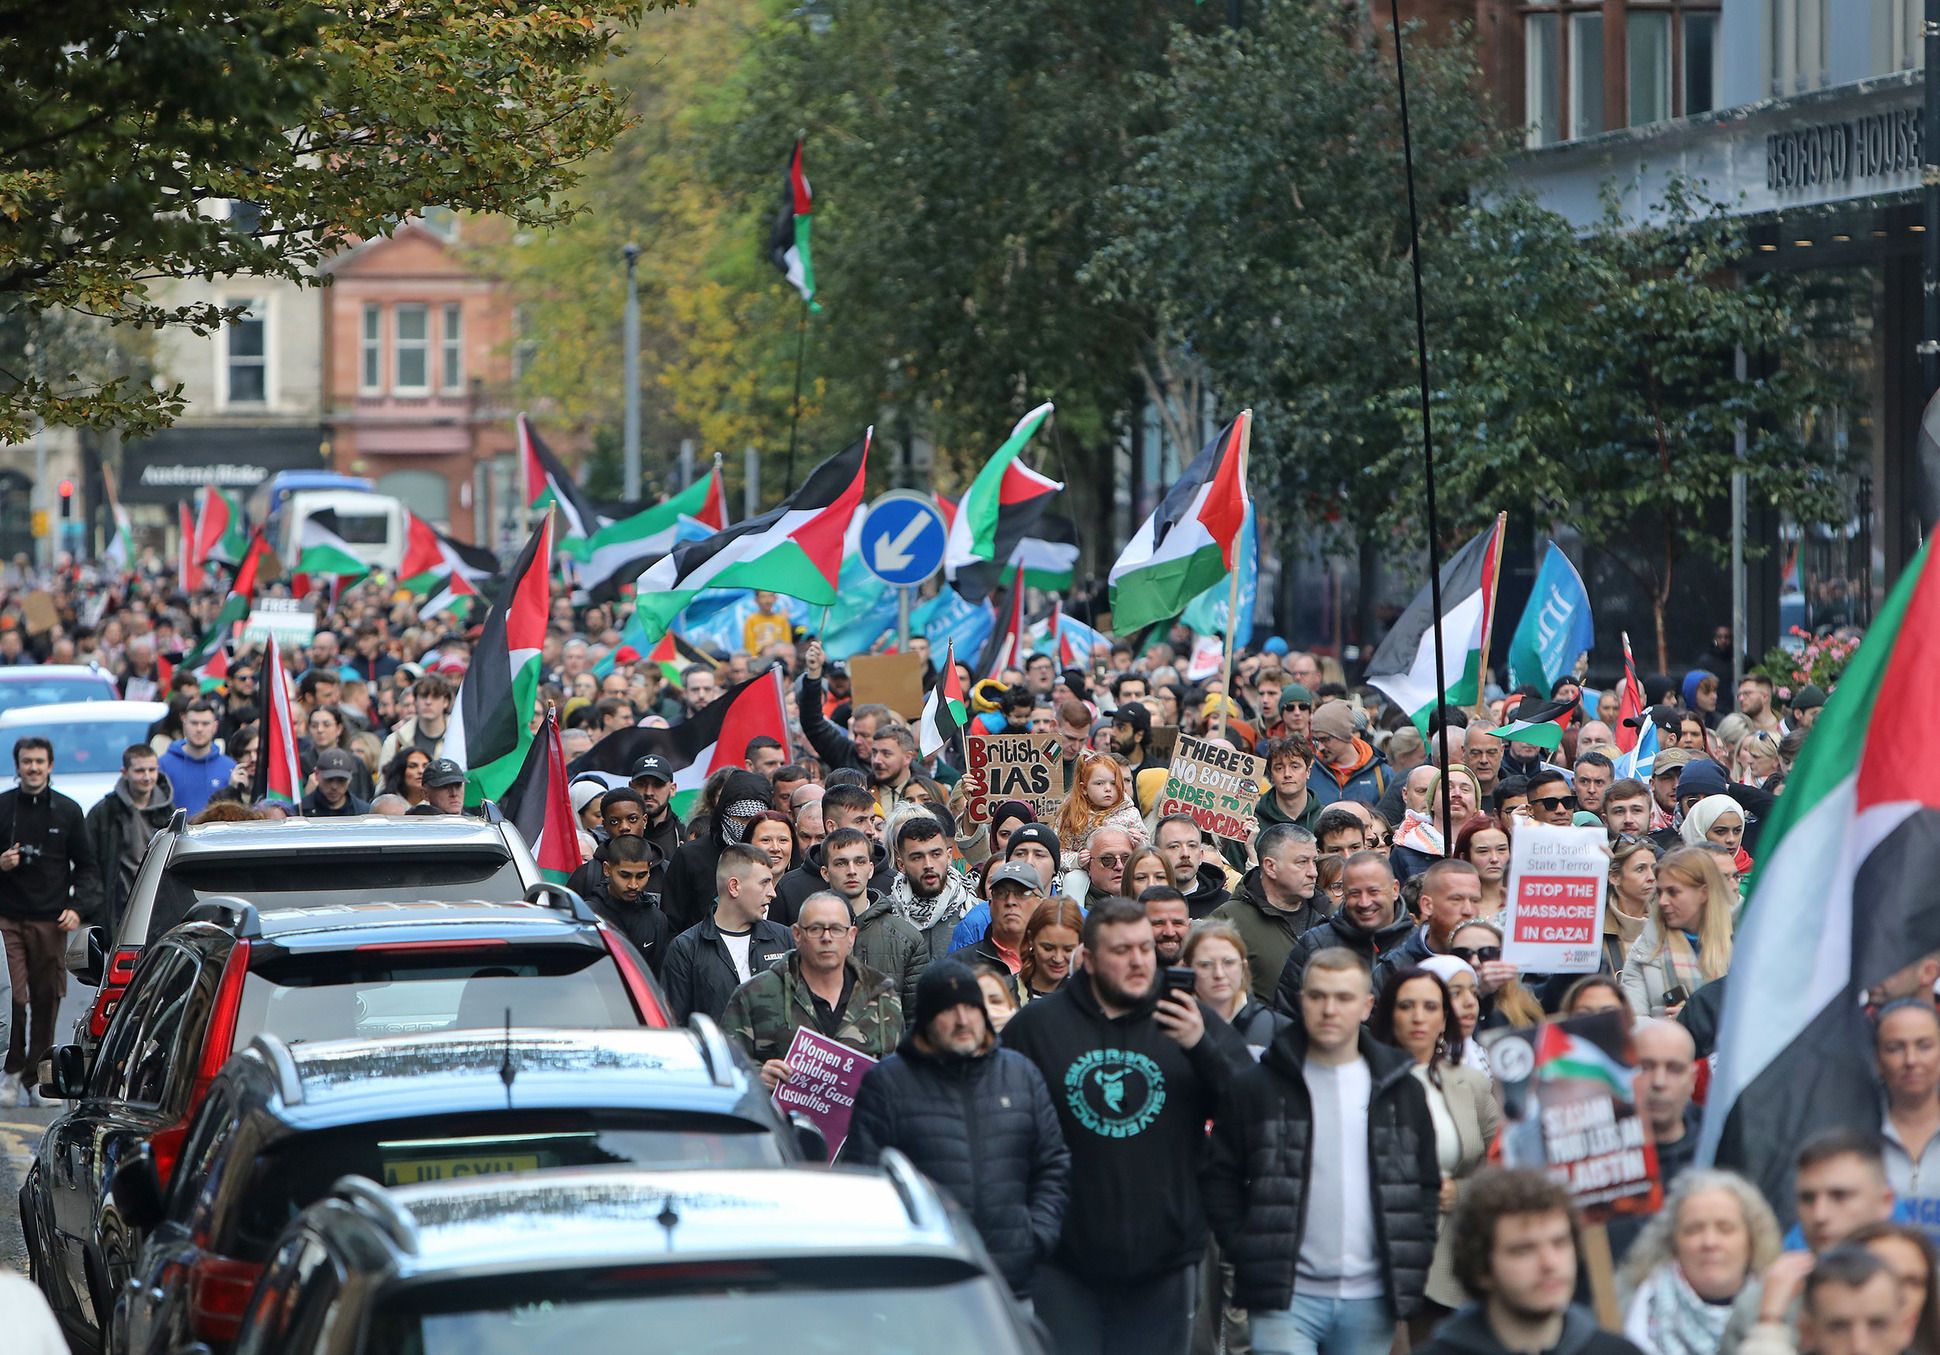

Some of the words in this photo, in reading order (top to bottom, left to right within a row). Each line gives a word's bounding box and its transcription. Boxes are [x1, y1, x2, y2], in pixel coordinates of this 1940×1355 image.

[1767, 122, 1848, 190] BEDFORD
[1857, 107, 1921, 177] HOUSE
[261, 598, 299, 612] FREE
[968, 737, 1040, 768] British
[1179, 736, 1255, 776] THERE'S
[970, 764, 1050, 797] BIAS
[1170, 757, 1197, 784] NO
[1199, 767, 1241, 794] BOTH
[1166, 777, 1216, 810] SIDES
[1220, 795, 1240, 811] TO
[1241, 802, 1253, 817] A
[1533, 842, 1554, 855] End
[1528, 860, 1557, 871] State
[1561, 860, 1594, 872] Terror
[1526, 883, 1563, 897] STOP
[1567, 884, 1594, 898] THE
[1518, 904, 1595, 918] MASSACRE
[1523, 926, 1540, 939] IN
[1543, 927, 1589, 941] GAZA!
[790, 1053, 839, 1085] Children
[797, 1035, 842, 1069] Women
[842, 1057, 855, 1073] &
[778, 1083, 831, 1114] Casualties
[810, 1082, 828, 1095] of
[825, 1086, 855, 1108] Gaza
